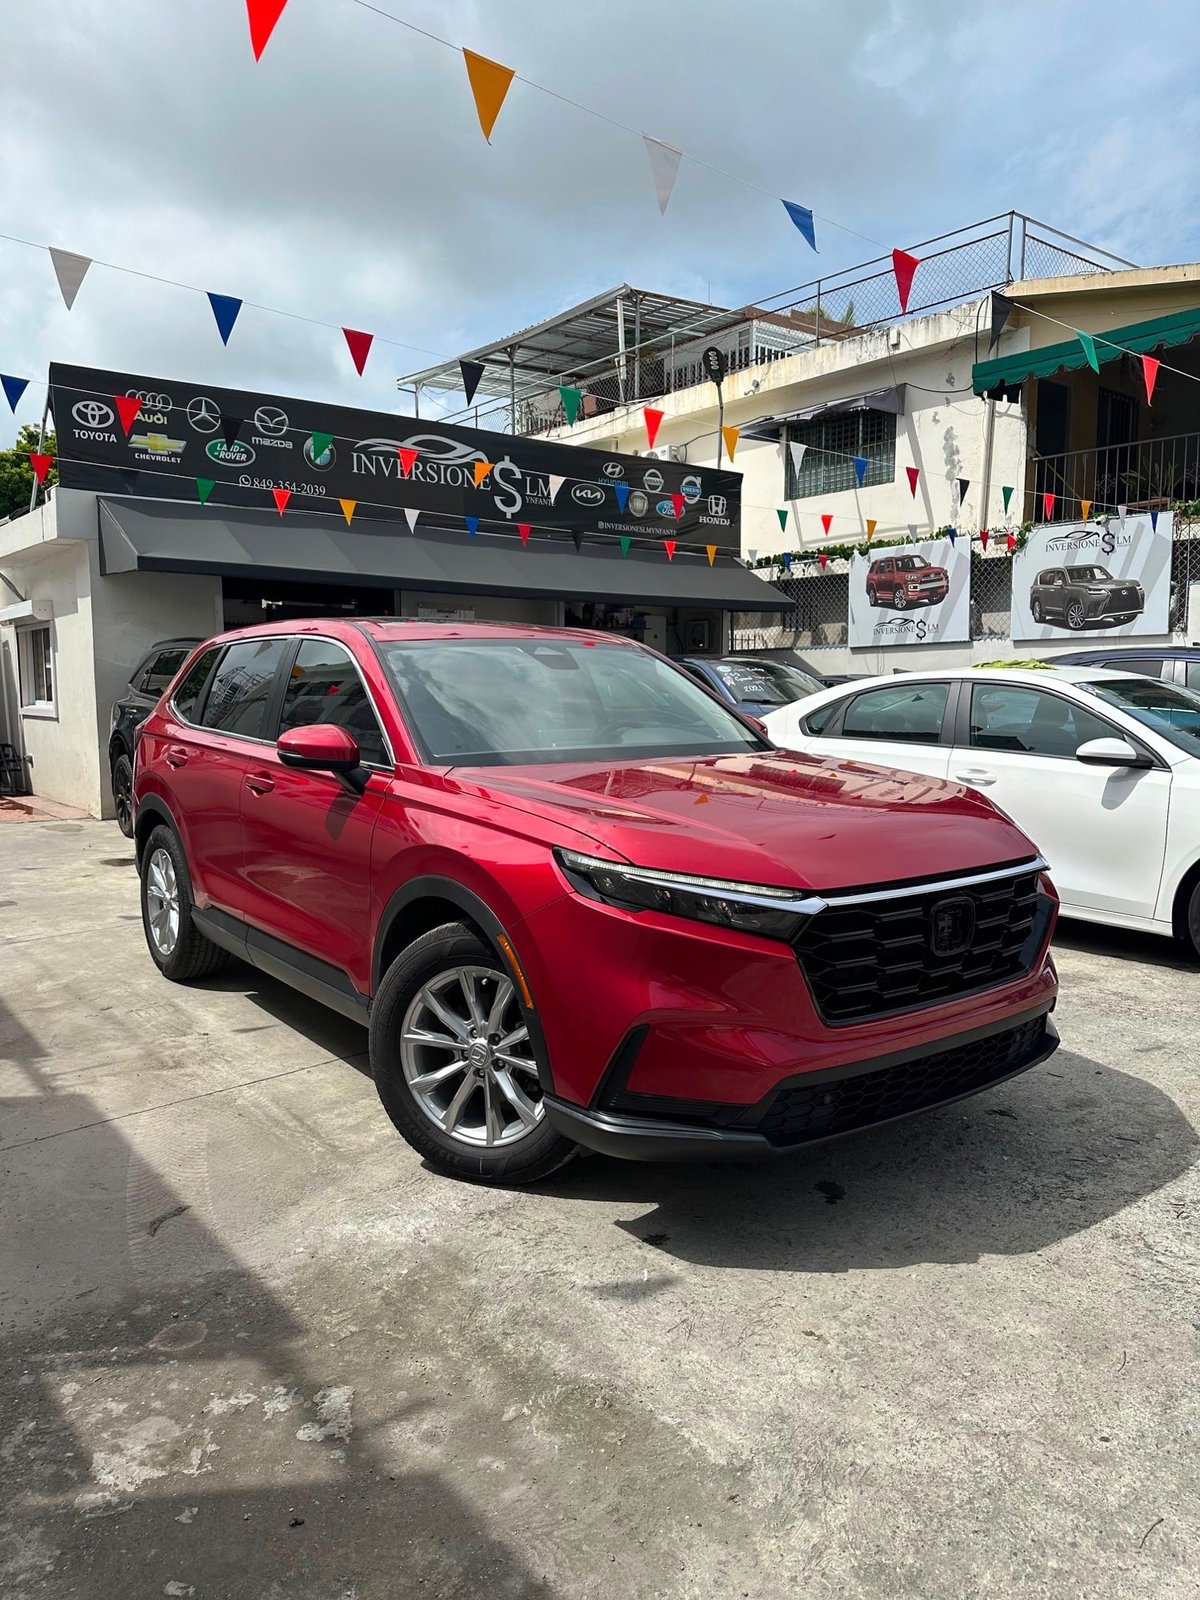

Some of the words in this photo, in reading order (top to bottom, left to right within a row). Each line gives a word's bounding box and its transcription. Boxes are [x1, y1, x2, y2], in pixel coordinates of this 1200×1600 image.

[134, 410, 167, 425] Audi
[73, 429, 117, 443] TOYOTA
[217, 443, 239, 453] LAD
[252, 437, 293, 449] mazda
[135, 452, 182, 463] CHEVROLET
[219, 451, 247, 461] ROVER
[253, 478, 326, 496] 849-354-2039
[682, 486, 700, 494] VOLVO
[525, 496, 556, 506] YNFANTE
